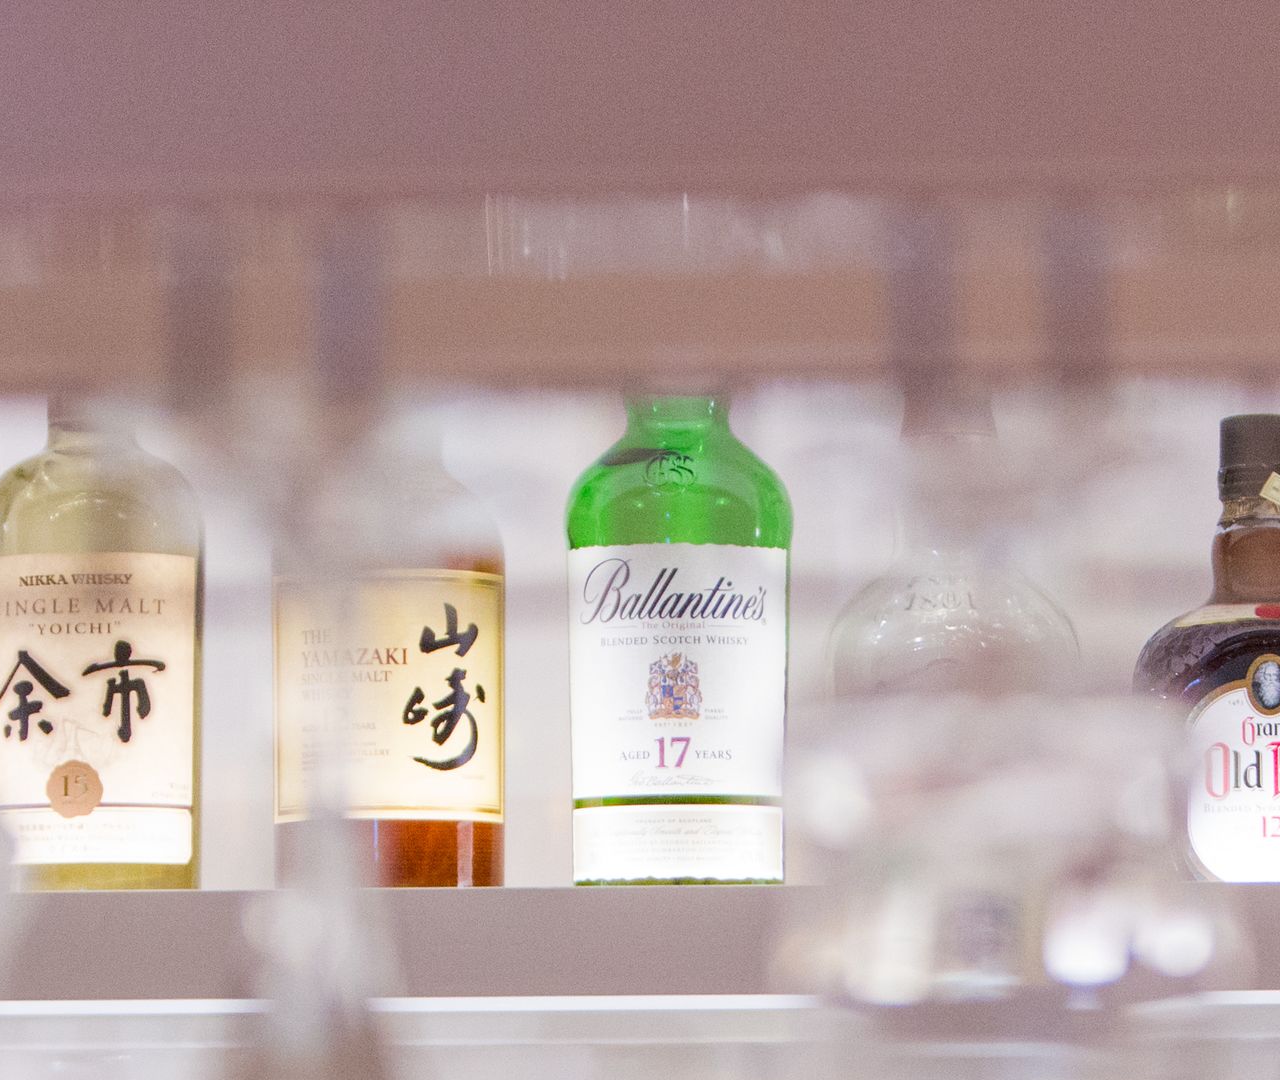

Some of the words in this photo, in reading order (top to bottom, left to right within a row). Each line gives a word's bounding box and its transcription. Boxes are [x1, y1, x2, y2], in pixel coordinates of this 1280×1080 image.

[19, 574, 68, 587] NIKKA
[72, 573, 133, 586] WHISKY
[580, 557, 767, 624] Ballantine's
[96, 599, 166, 615] MALT
[29, 621, 121, 635] "YOICHI"
[662, 621, 706, 630] Original
[302, 630, 331, 645] THE
[601, 637, 648, 646] BLENDED
[653, 635, 701, 645] SCOTCH
[706, 635, 750, 646] WHISKY
[302, 648, 408, 668] YAMAZAKI
[351, 670, 393, 682] MALT
[402, 602, 487, 772] 山崎
[620, 751, 650, 761] AGED
[654, 736, 691, 768] 17
[695, 749, 733, 760] YEARS
[1204, 741, 1264, 800] Old
[62, 775, 89, 797] 15
